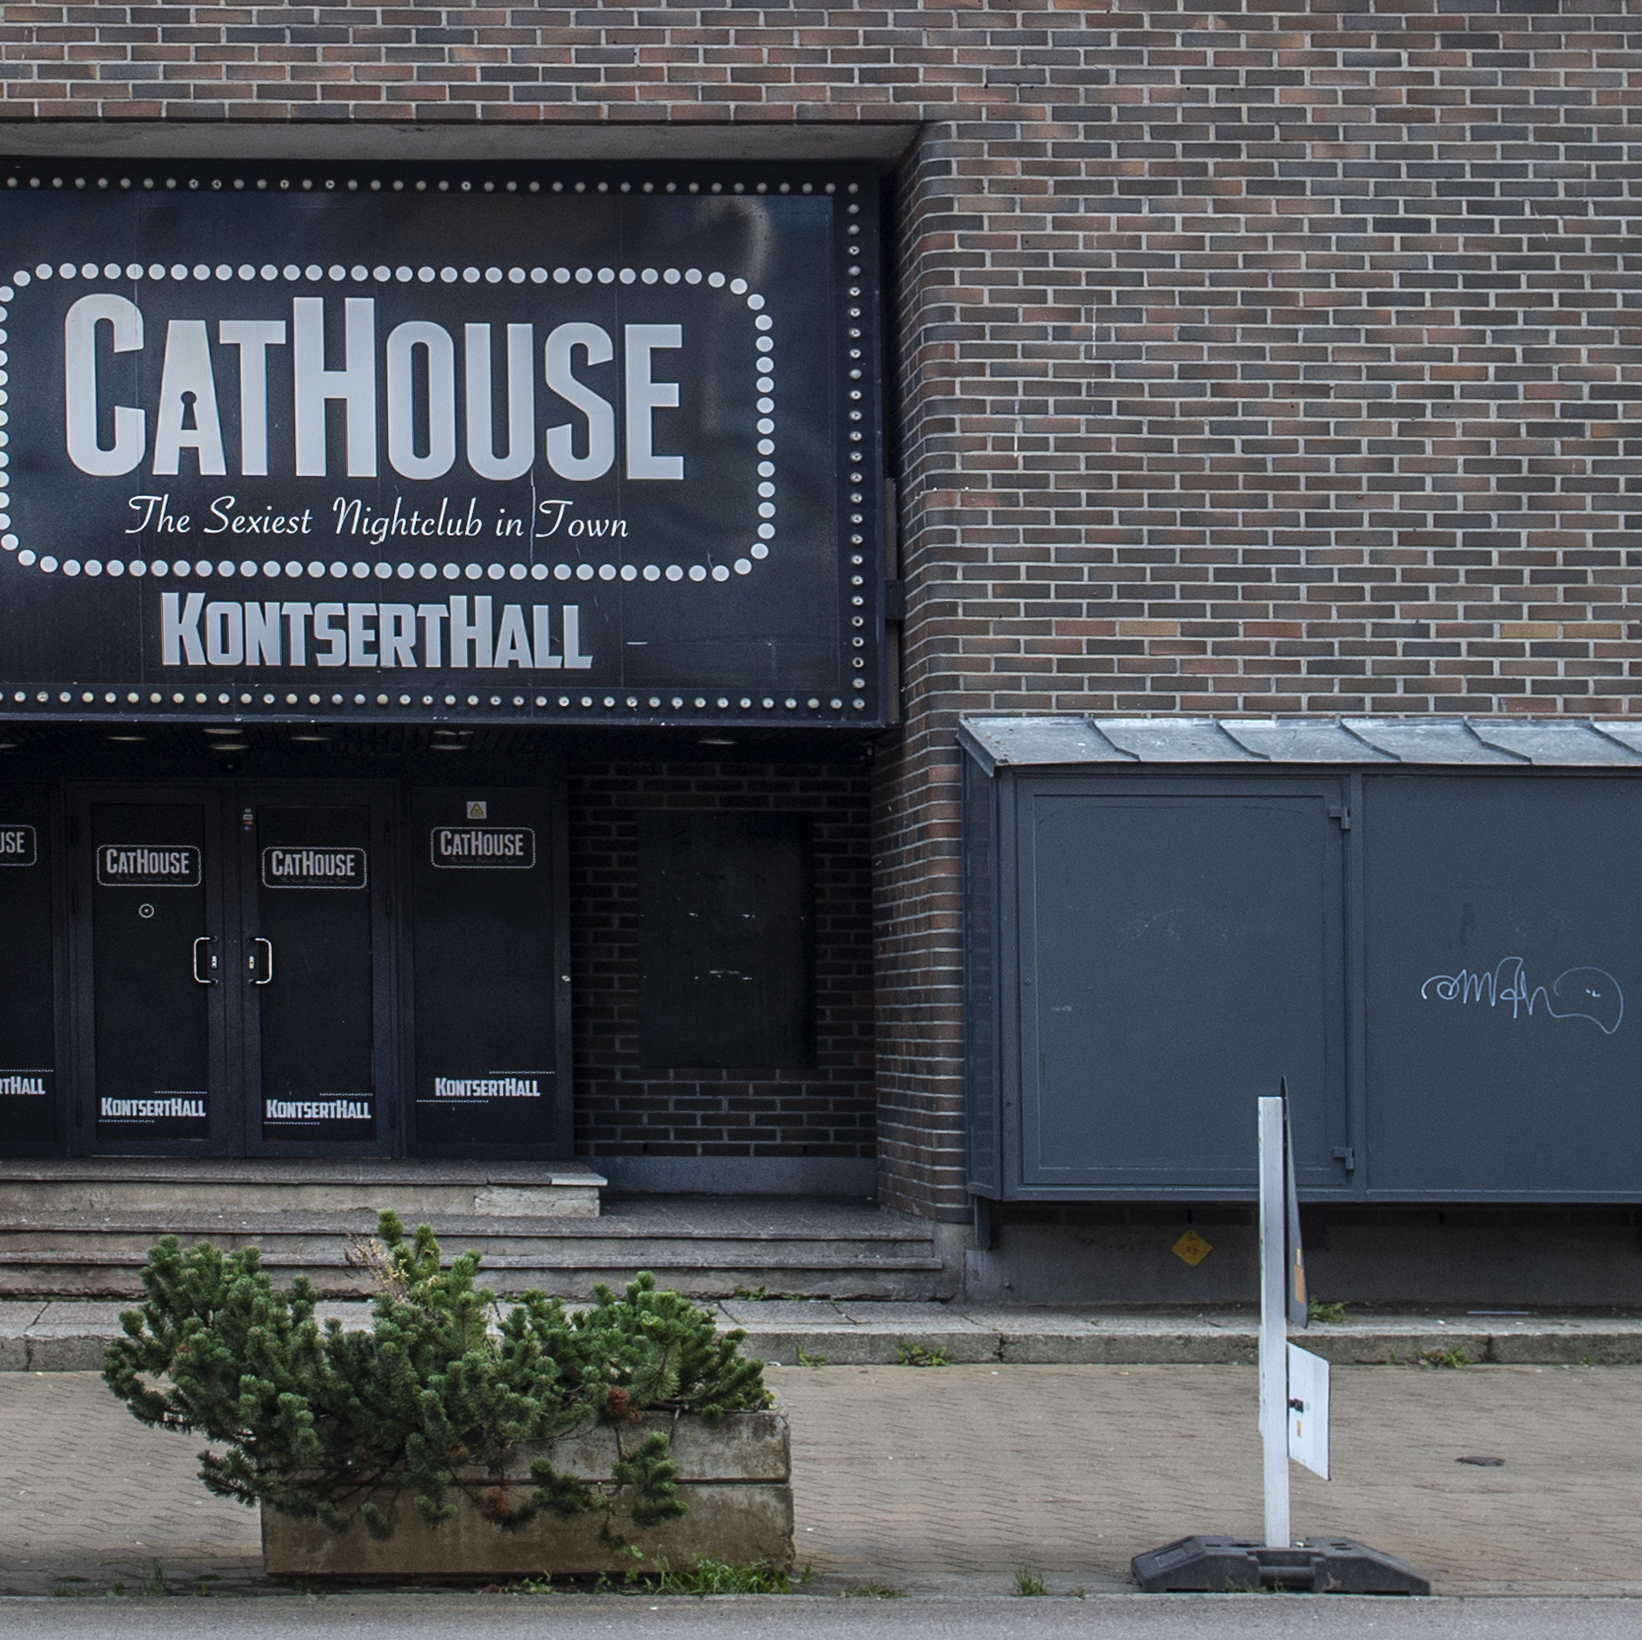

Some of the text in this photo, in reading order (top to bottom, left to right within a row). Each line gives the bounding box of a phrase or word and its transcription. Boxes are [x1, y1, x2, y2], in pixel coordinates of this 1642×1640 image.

[125, 493, 629, 546] The Sexiest Nightclub in Town
